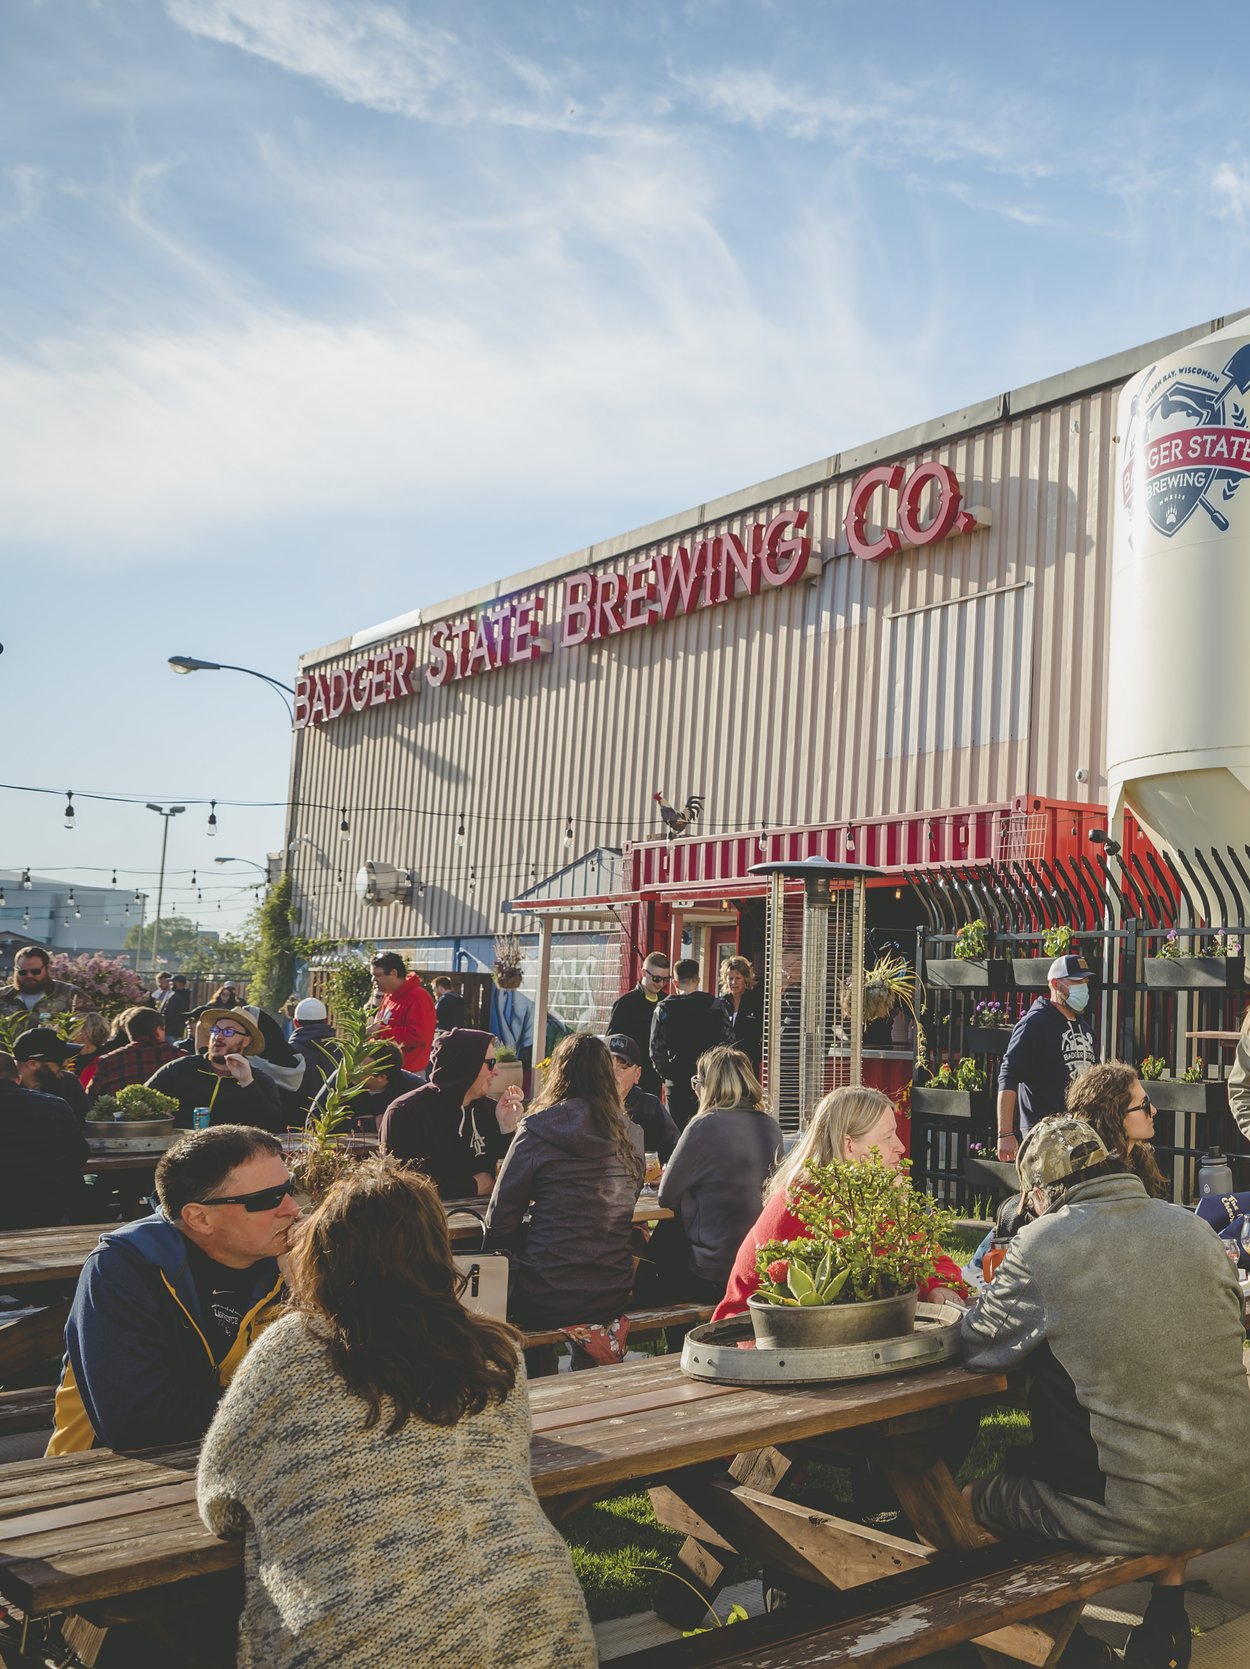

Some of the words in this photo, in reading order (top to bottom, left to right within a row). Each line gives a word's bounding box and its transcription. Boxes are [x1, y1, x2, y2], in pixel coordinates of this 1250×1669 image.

[1178, 366, 1220, 384] WISCONSIN
[1123, 438, 1183, 496] BGER
[1145, 471, 1206, 501] BREWING
[292, 645, 417, 731] BADGER
[425, 600, 541, 688] STATE
[560, 508, 812, 648] BREWING
[843, 461, 978, 561] CO.
